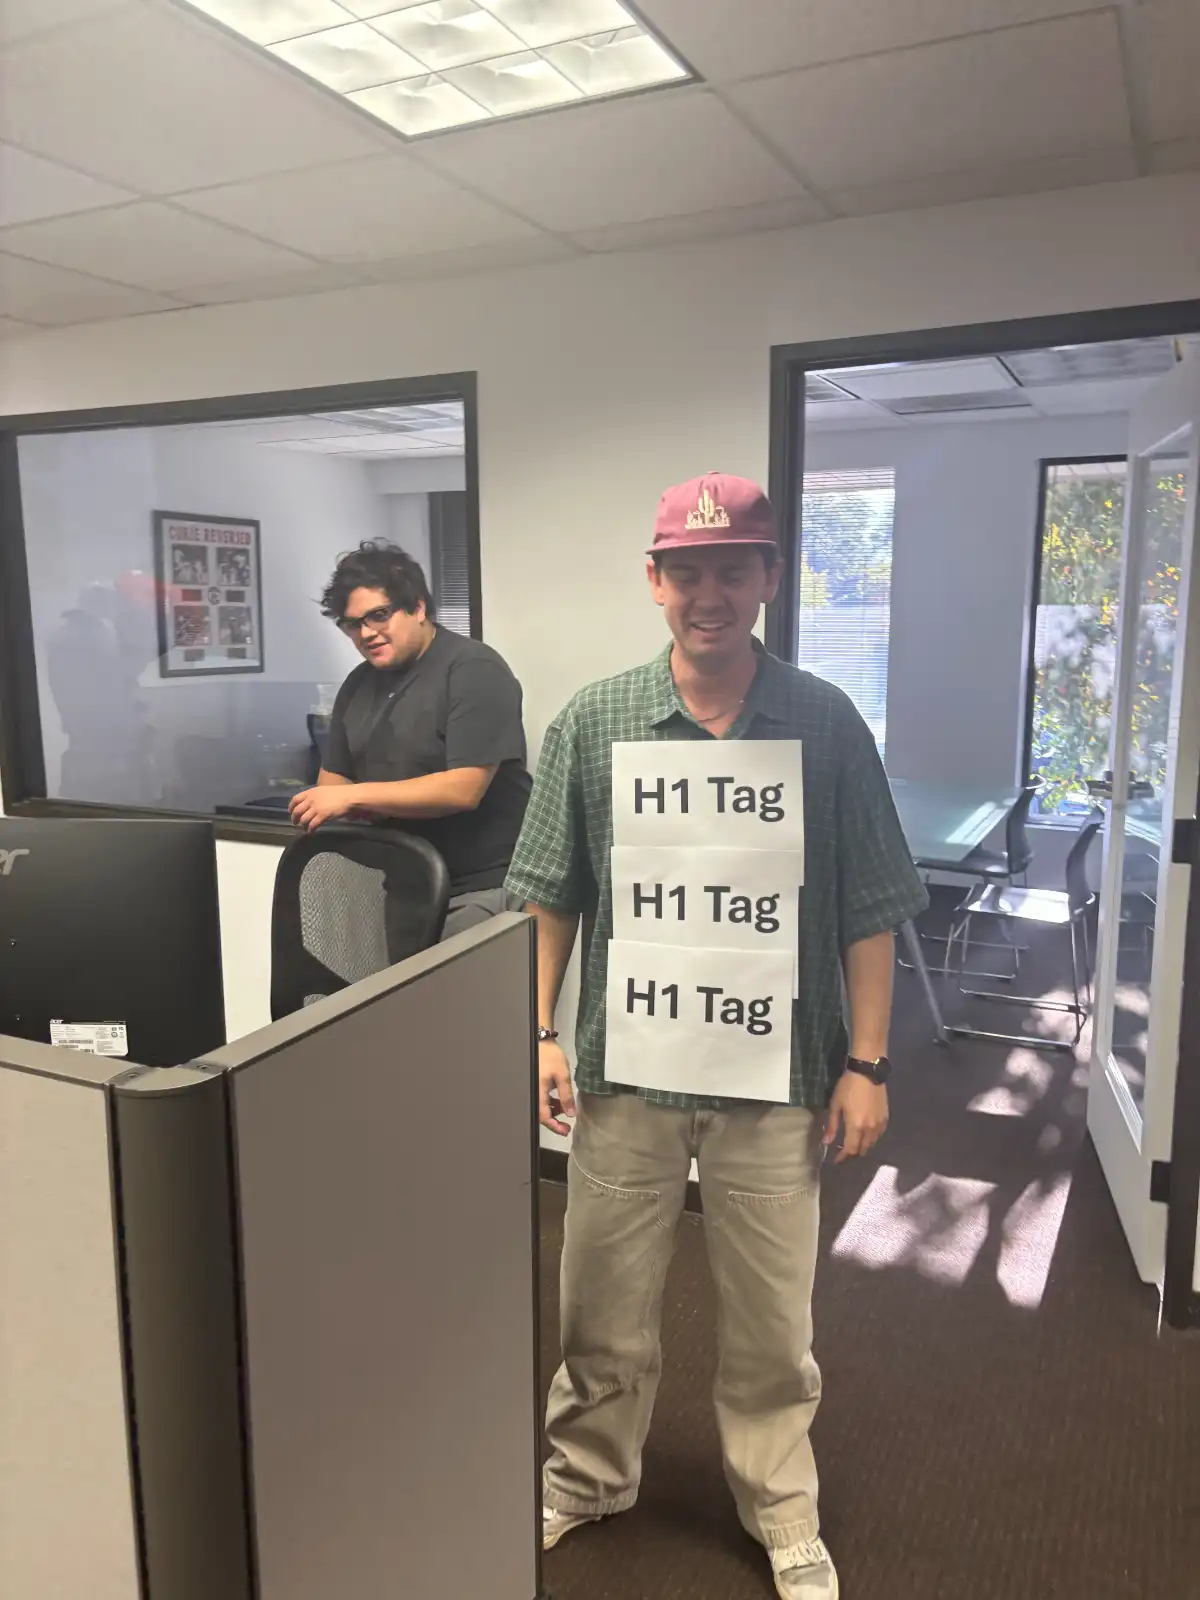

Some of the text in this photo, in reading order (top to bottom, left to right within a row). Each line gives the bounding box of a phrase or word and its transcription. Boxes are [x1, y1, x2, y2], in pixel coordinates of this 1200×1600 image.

[635, 777, 784, 822] H1 Tag
[634, 883, 779, 933] H1 Tag
[627, 978, 773, 1035] H1 Tag
